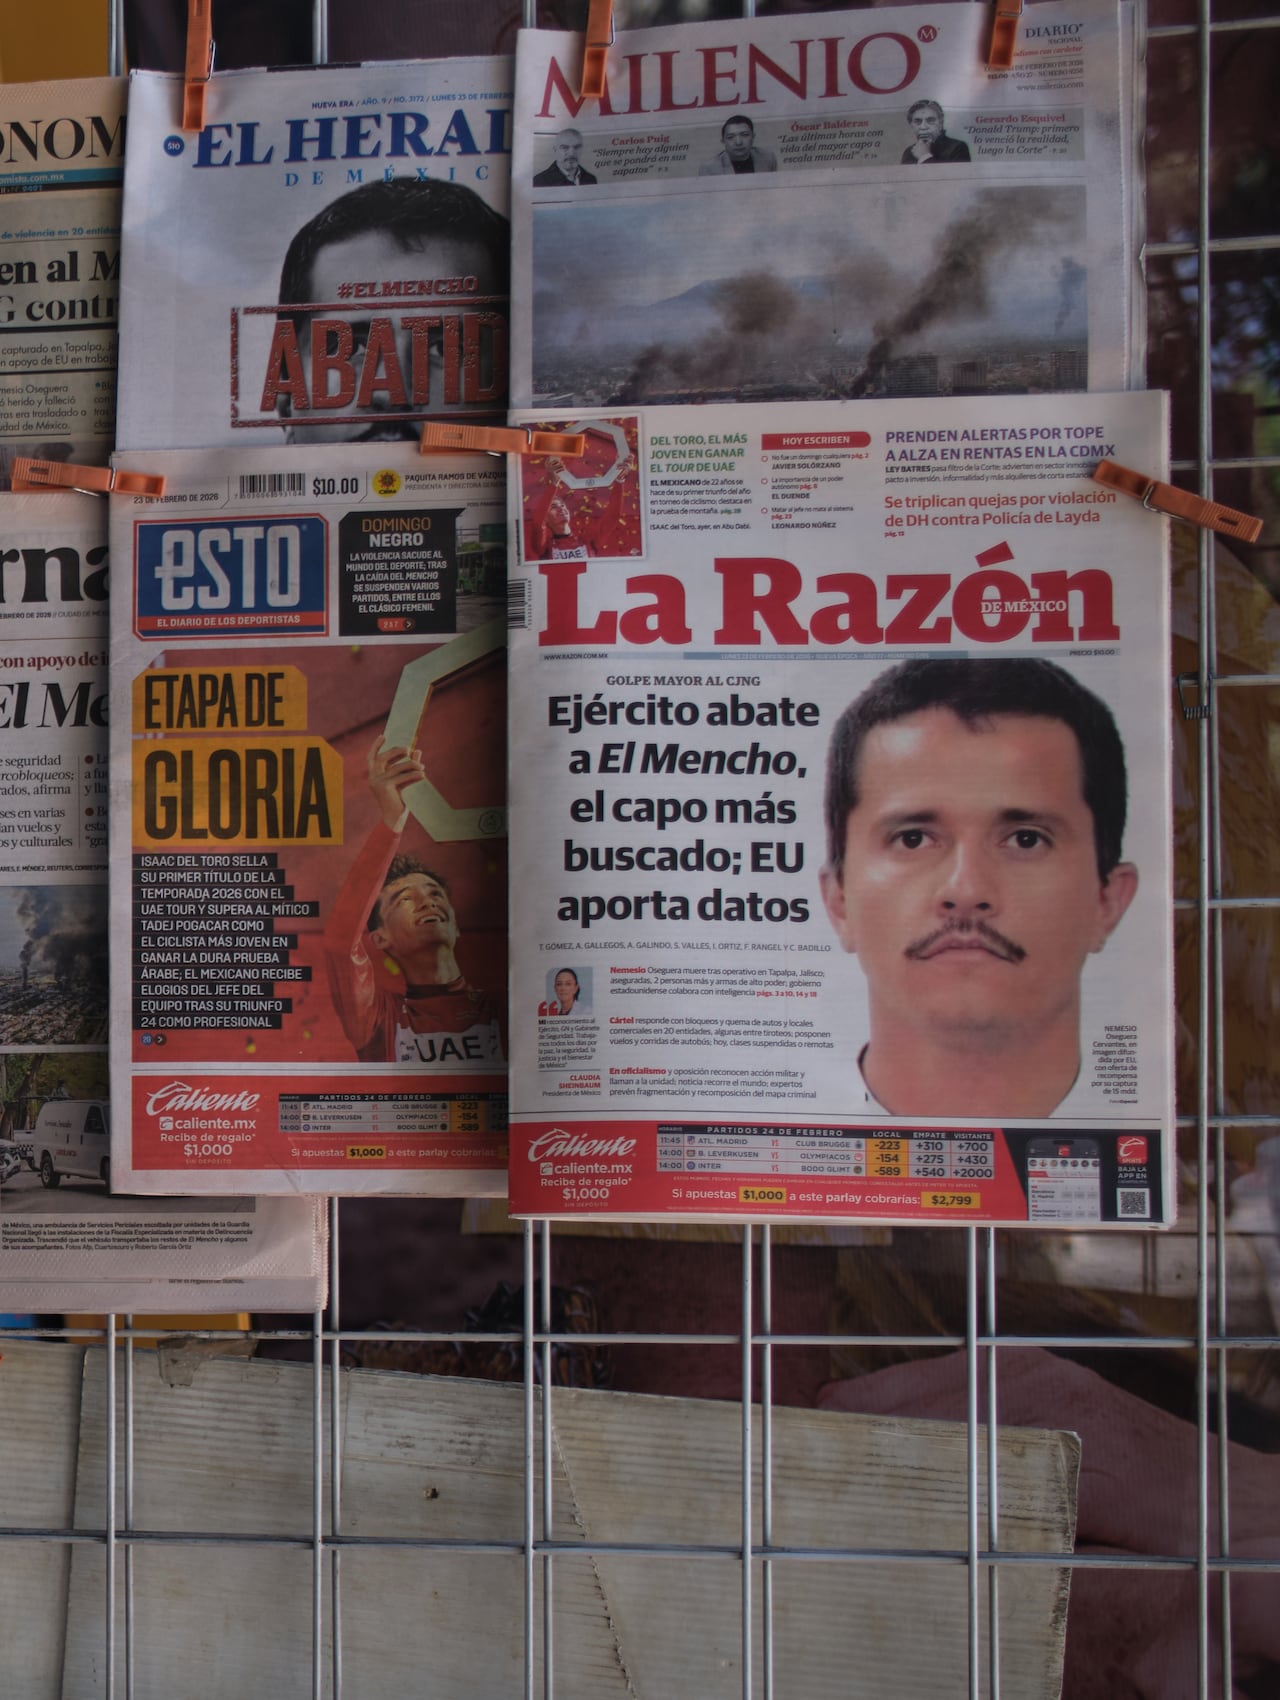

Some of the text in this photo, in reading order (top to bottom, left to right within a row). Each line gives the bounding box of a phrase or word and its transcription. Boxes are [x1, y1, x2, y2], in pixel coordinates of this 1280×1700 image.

[534, 32, 921, 119] MILENIO
[976, 114, 1065, 124] Gerardo Esquivel
[192, 122, 274, 168] EL
[611, 134, 670, 145] Carlos Puig
[285, 171, 324, 187] DE
[46, 251, 80, 282] al
[337, 276, 479, 299] #ELMENCHO
[2, 345, 48, 358] capturado
[51, 345, 62, 353] en
[650, 433, 747, 446] DEL TORO, EL MÁS
[783, 435, 850, 446] HOY ESCRIBEN
[886, 427, 1104, 443] PRENDEN ALERTAS POR TOPE
[650, 448, 744, 460] JOVEN EN GANAR
[886, 445, 1115, 461] A ALZA EN RENTAS EN LA CDMX
[650, 462, 735, 473] EL TOUR DE UAE
[313, 479, 358, 495] $10.00
[885, 491, 1116, 510] Se triplican quejas por violación
[363, 517, 431, 532] DOMINGO
[885, 510, 1100, 527] de DH contra Policía de Layda
[370, 533, 423, 547] NEGRO
[538, 541, 1121, 647] La Razón
[981, 598, 1067, 614] DE MÉXICO
[158, 615, 300, 627] EL DIARIO DE LOS DEPORTISTAS
[27, 655, 76, 671] apoyo
[79, 653, 98, 666] de
[606, 676, 760, 686] GOLPE MAYOR AL CJNG
[144, 672, 284, 729] ETAPA DE
[548, 694, 820, 734] Ejército abate
[569, 742, 806, 778] a El Mencho,
[144, 748, 332, 840] GLORIA
[570, 790, 796, 830] el capo más
[141, 856, 268, 866] ISAAC DEL TORO SELLA
[564, 840, 804, 874] buscado; EU
[557, 888, 810, 928] aporta datos
[418, 1035, 485, 1062] UAE
[708, 1126, 758, 1134] PARTIDOS
[528, 1128, 637, 1162] Caliente
[554, 1162, 632, 1174] caliente.mx
[541, 1178, 576, 1186] Recibe
[578, 1178, 592, 1186] de
[563, 1188, 609, 1200] $1,000
[672, 1189, 682, 1198] Si
[686, 1190, 736, 1201] apuestas
[743, 1190, 783, 1200] $1,000
[799, 1193, 823, 1202] este
[826, 1193, 862, 1204] parlay
[865, 1194, 920, 1204] cobrarías:
[931, 1196, 971, 1205] $2,799
